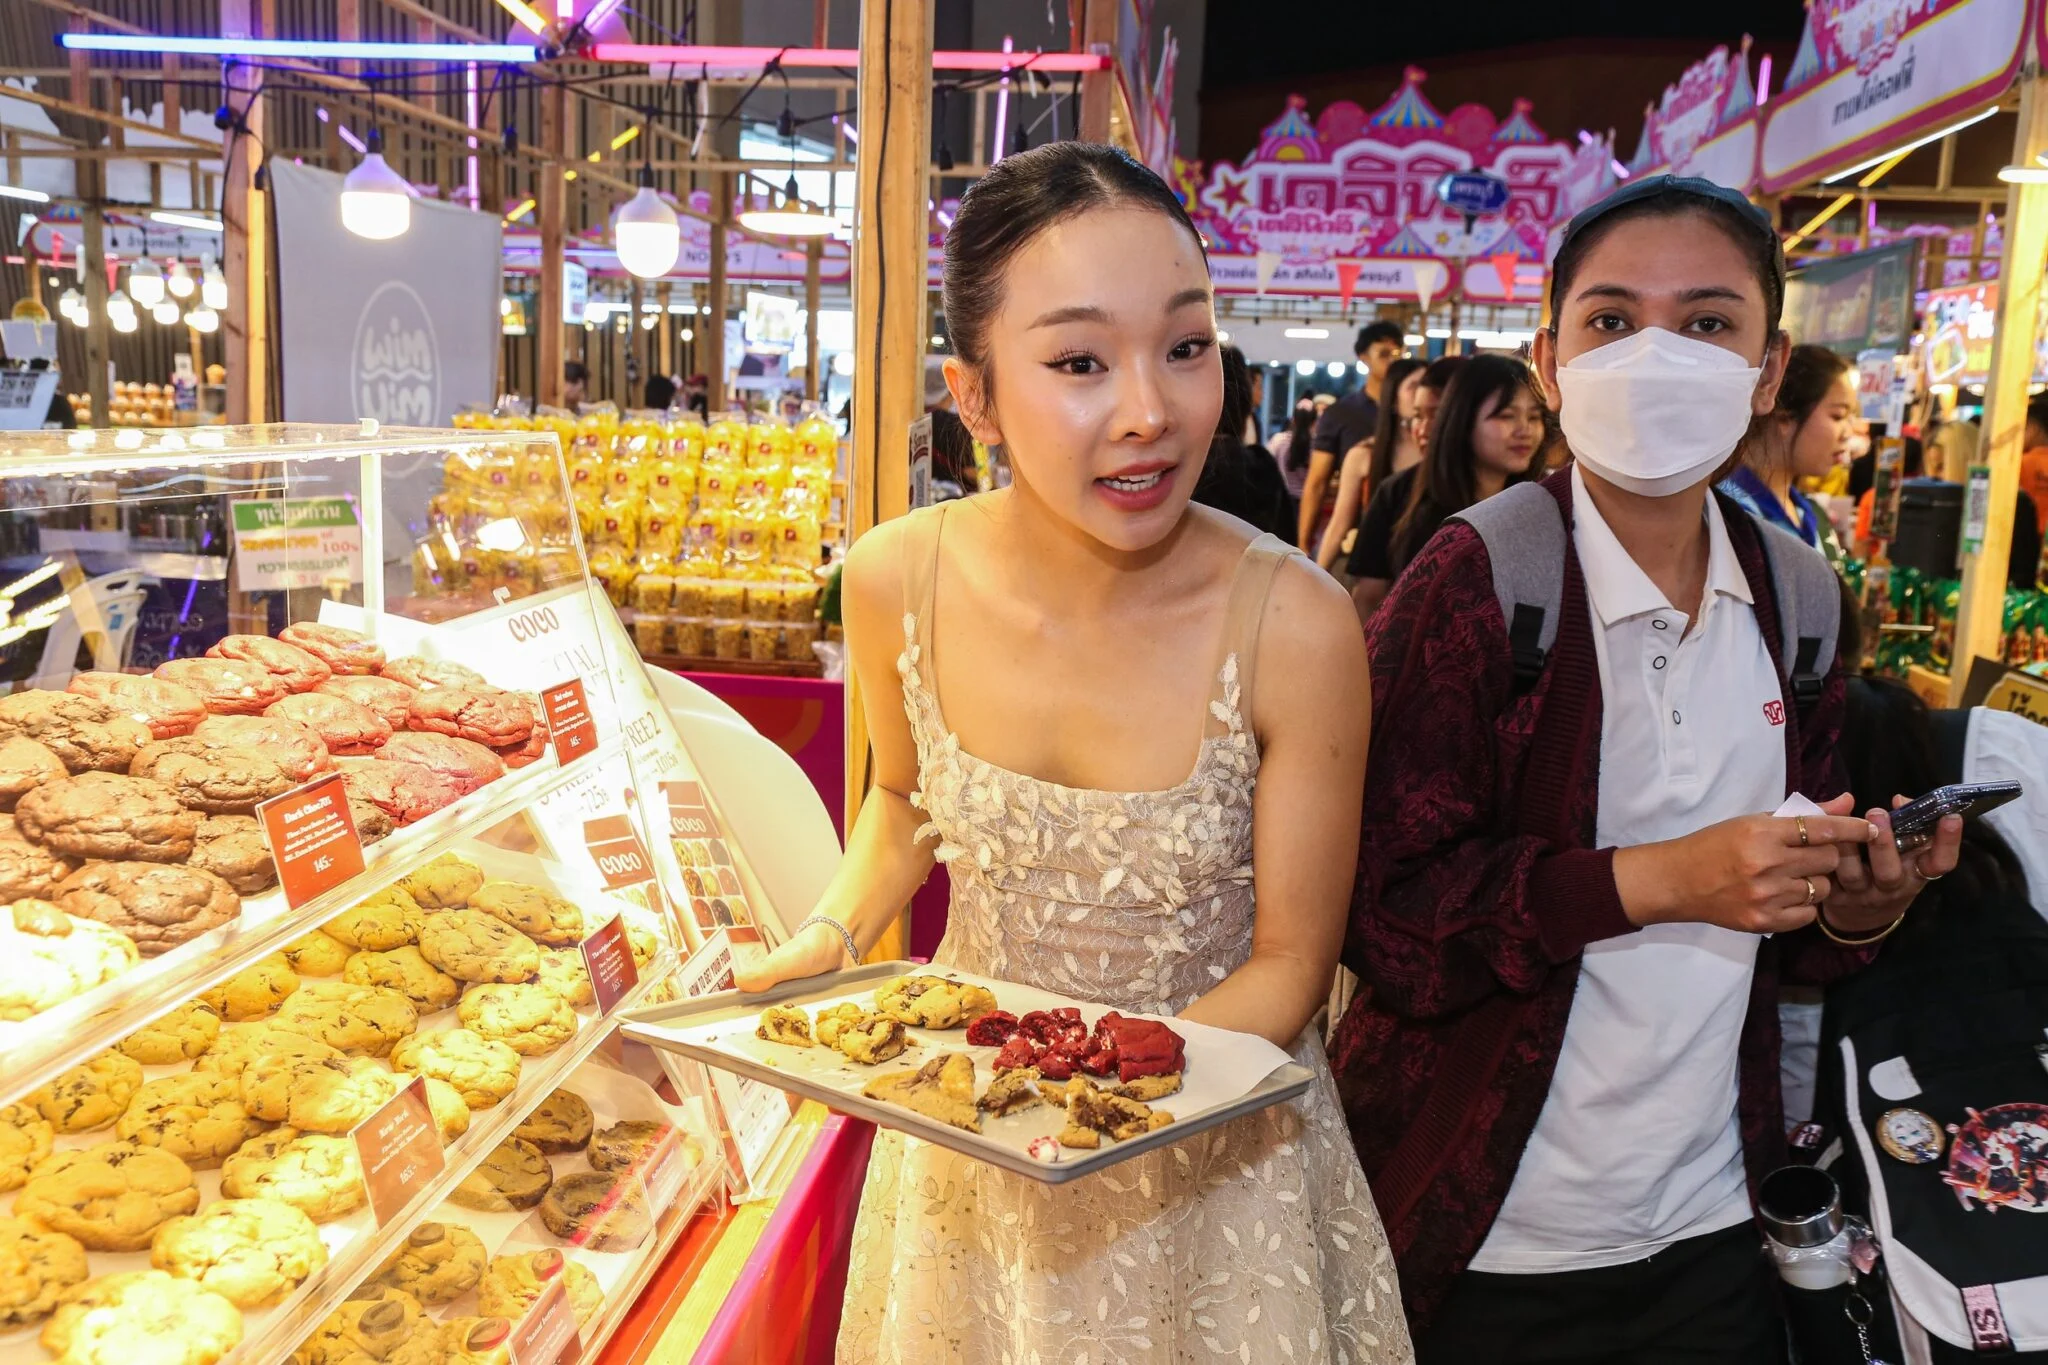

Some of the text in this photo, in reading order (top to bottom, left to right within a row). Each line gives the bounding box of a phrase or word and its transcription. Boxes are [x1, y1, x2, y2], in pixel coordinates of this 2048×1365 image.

[508, 606, 560, 643] COCO
[672, 816, 707, 833] COCO
[599, 851, 642, 875] COCO
